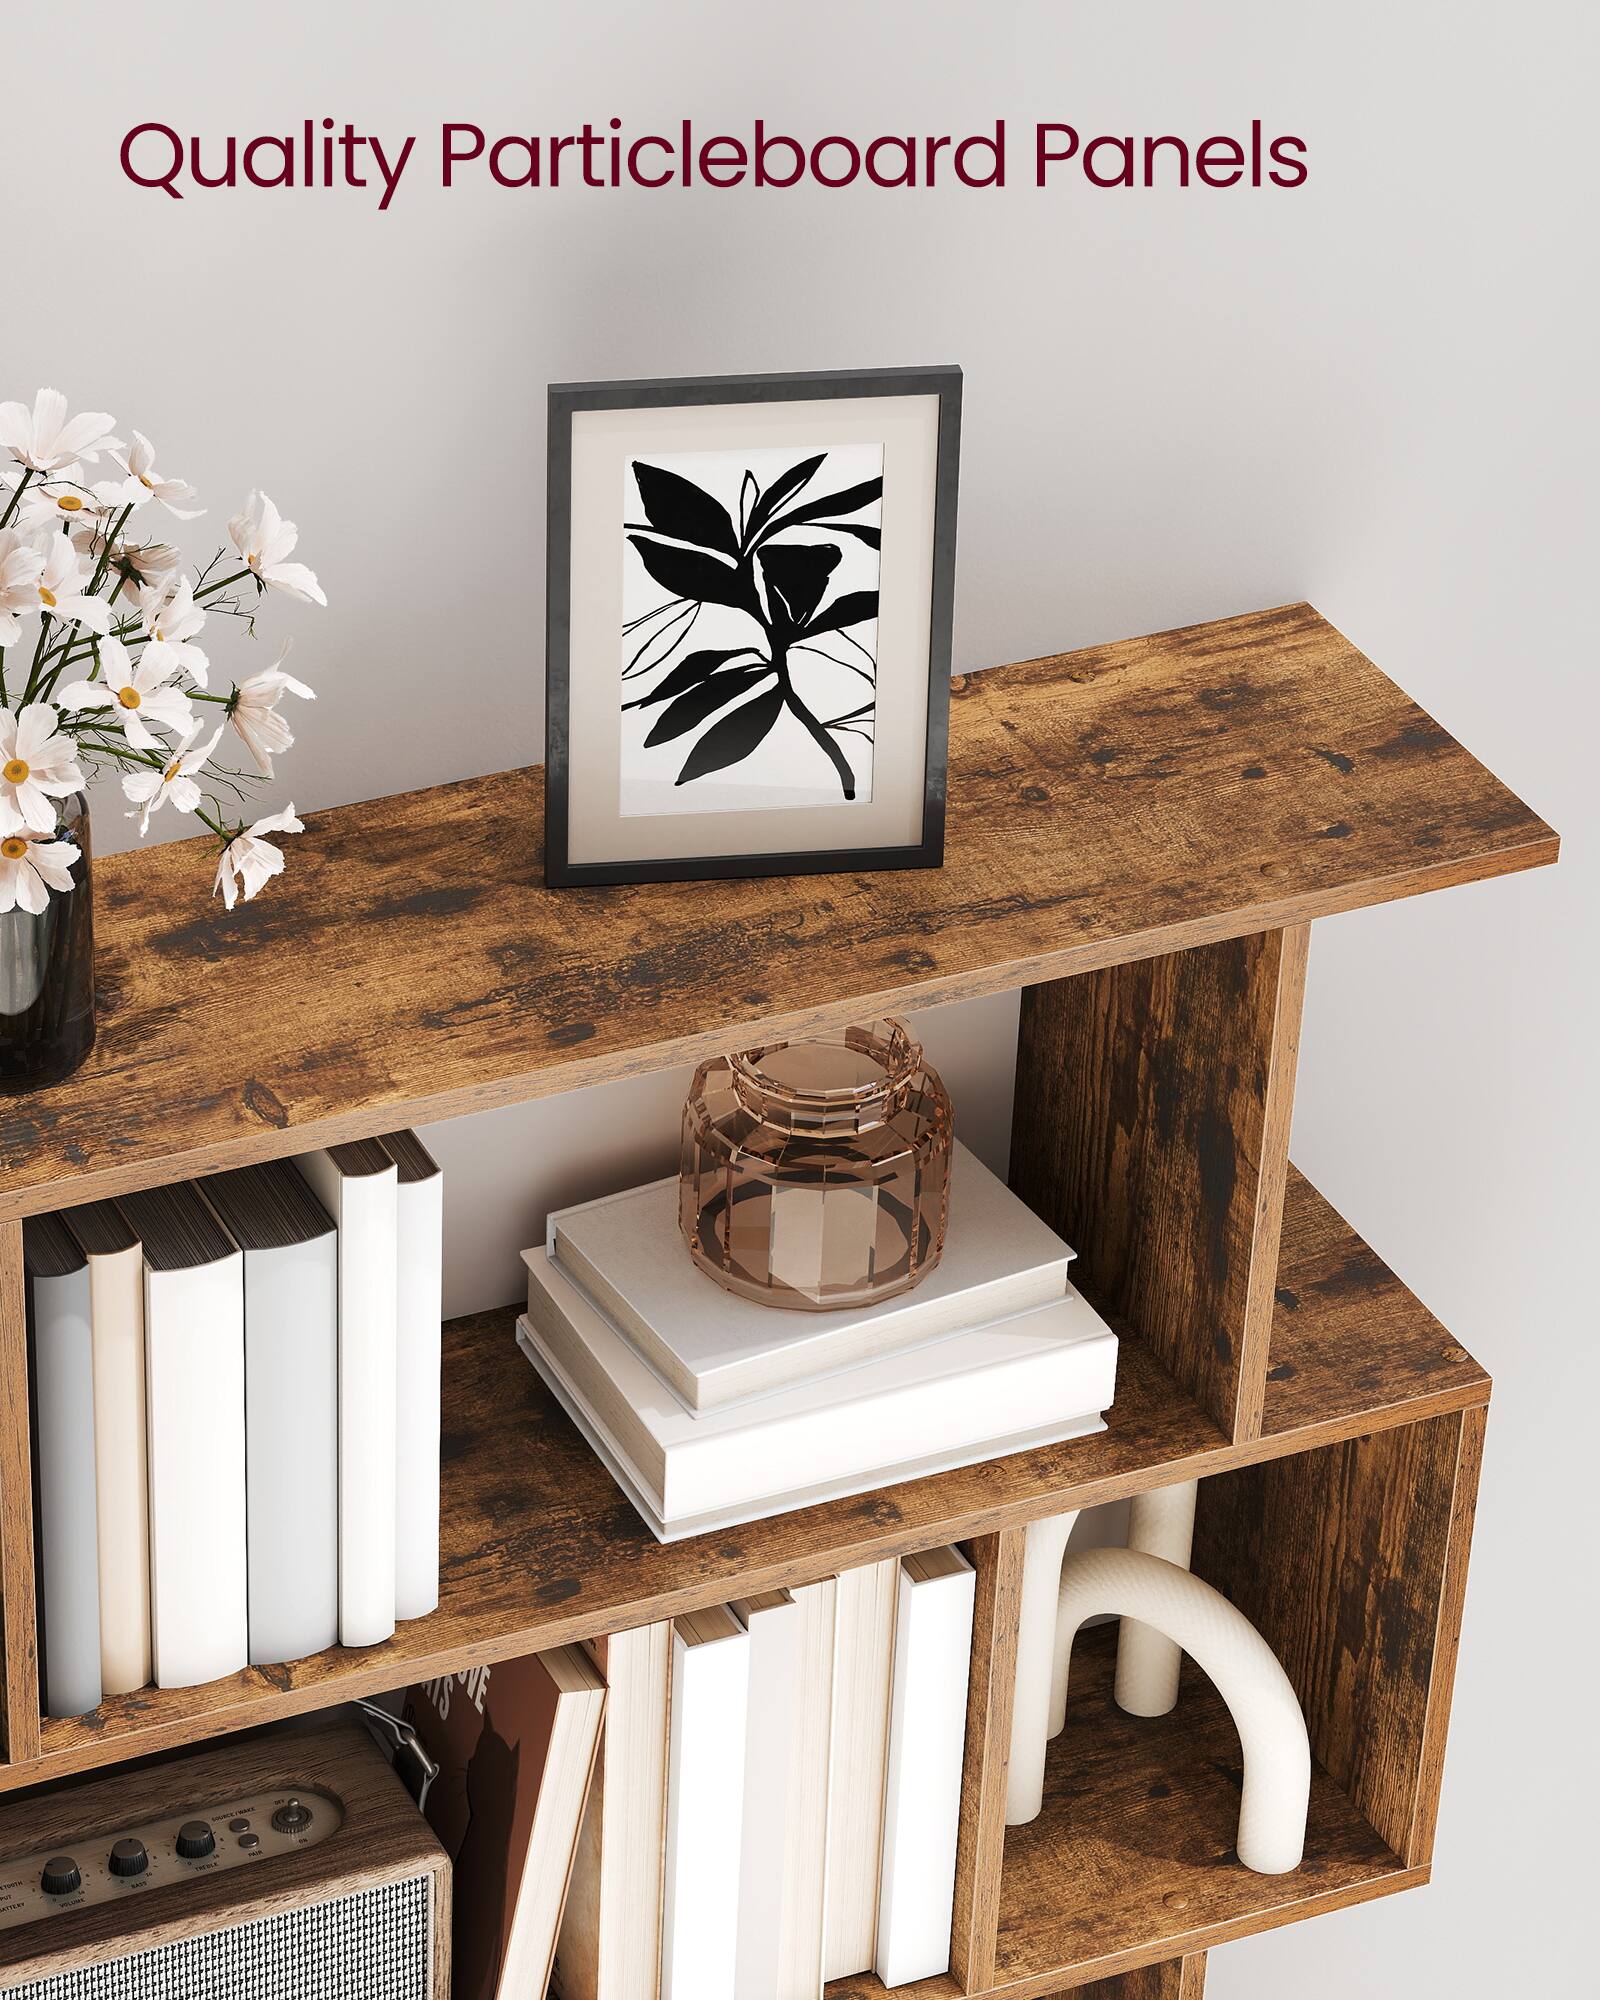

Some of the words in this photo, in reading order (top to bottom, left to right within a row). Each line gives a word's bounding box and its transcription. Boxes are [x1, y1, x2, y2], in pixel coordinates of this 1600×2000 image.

[247, 1849, 264, 1858] PAIR
[195, 1861, 218, 1872] TREBLE
[131, 1880, 148, 1889] BASS
[59, 1897, 86, 1908] VOLUME
